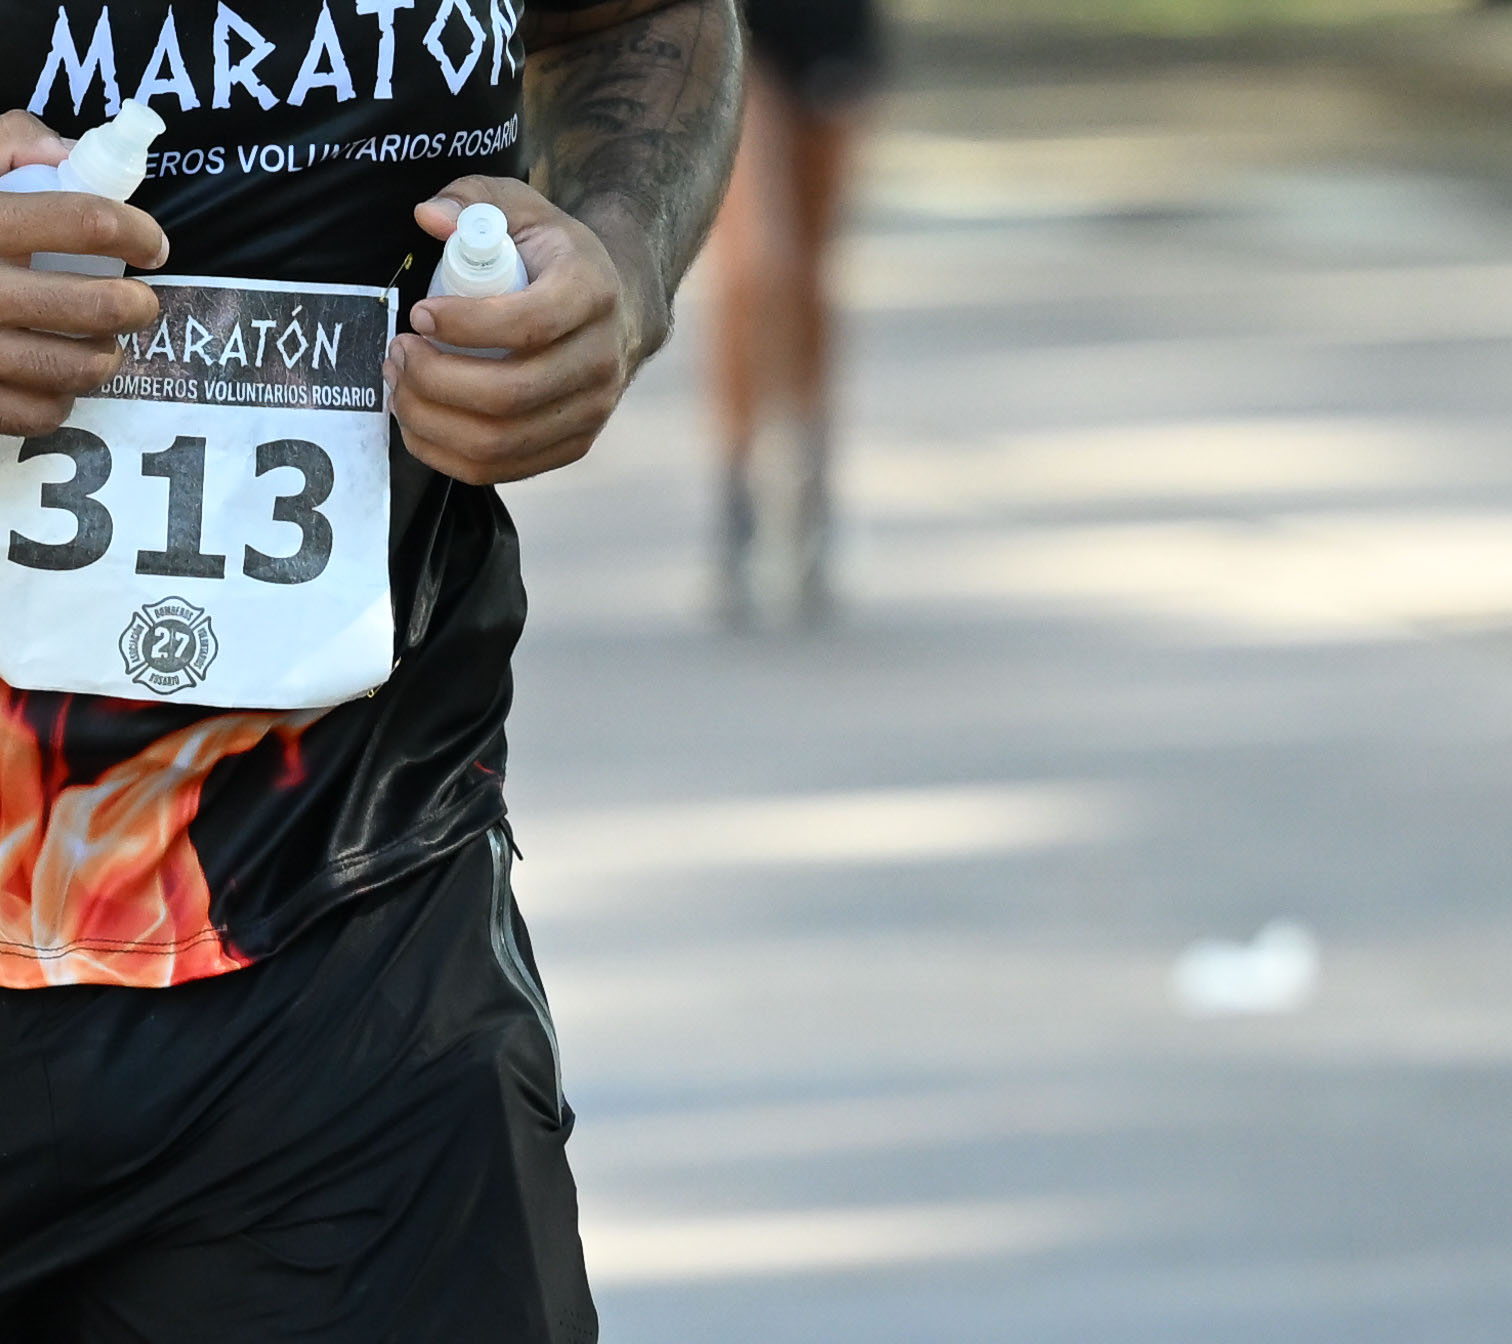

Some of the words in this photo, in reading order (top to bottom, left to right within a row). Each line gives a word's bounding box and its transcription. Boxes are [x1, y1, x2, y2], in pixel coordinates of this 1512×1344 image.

[447, 112, 519, 158] ROSARIO
[204, 380, 308, 405] VOLUNTARIOS
[311, 384, 377, 408] ROSARIO
[7, 426, 335, 585] 313
[150, 626, 190, 659] 27
